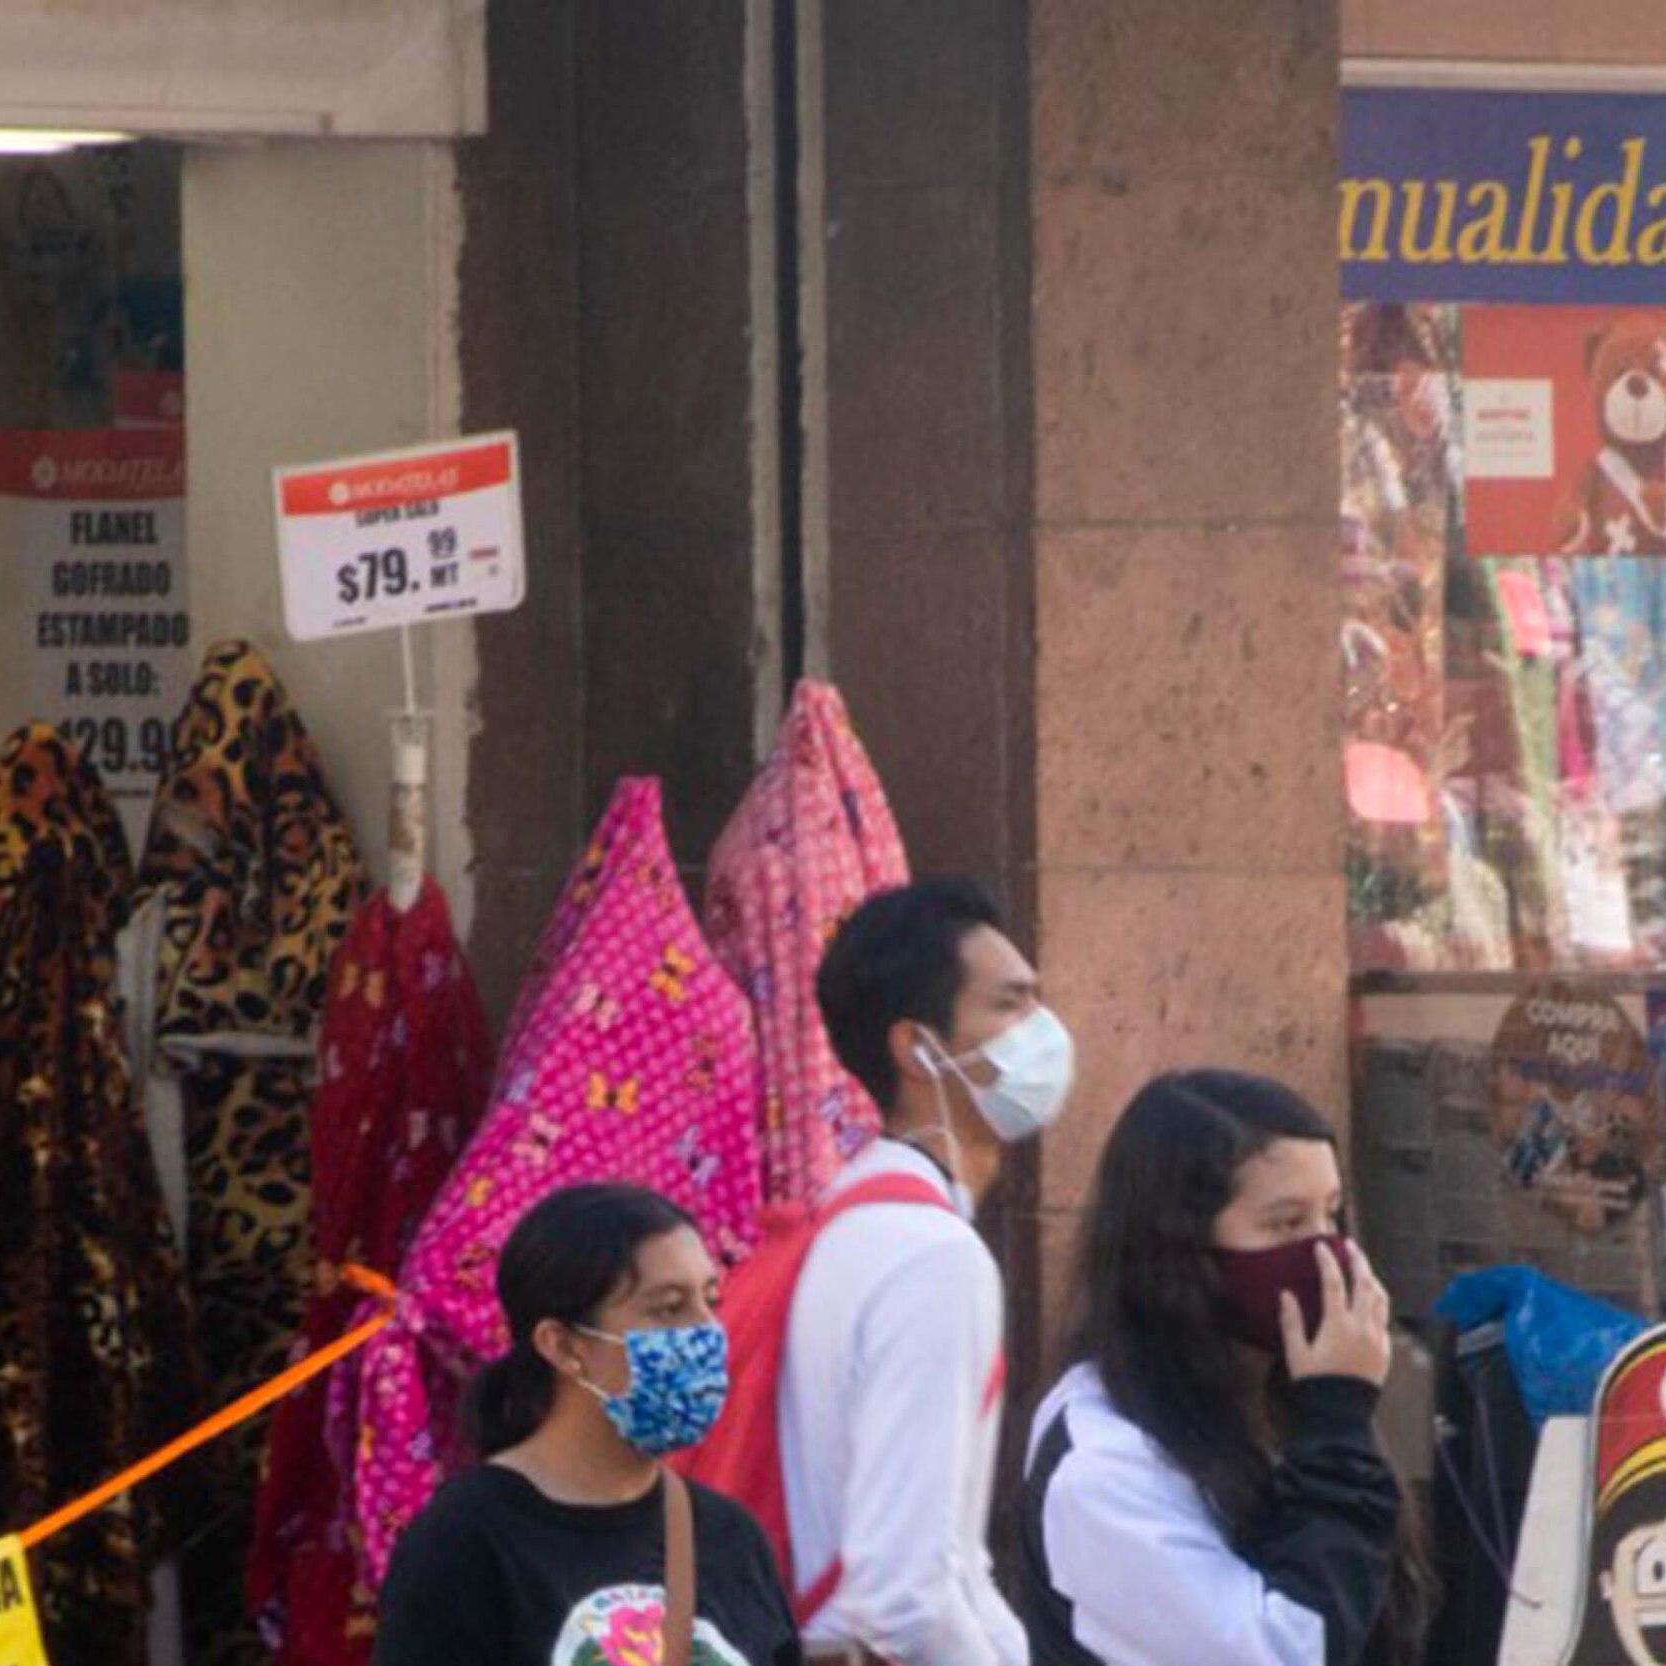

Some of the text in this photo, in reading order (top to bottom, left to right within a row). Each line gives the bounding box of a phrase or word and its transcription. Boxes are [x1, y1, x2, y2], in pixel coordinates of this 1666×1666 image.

[70, 510, 159, 546] FLANEL
[355, 505, 401, 528] SUPER
[51, 560, 172, 597] GOFRADO
[430, 562, 459, 587] MT
[37, 611, 191, 648] ESTAMPADO
[65, 661, 161, 697] A SOLO:
[1526, 1000, 1622, 1033] COMPRA
